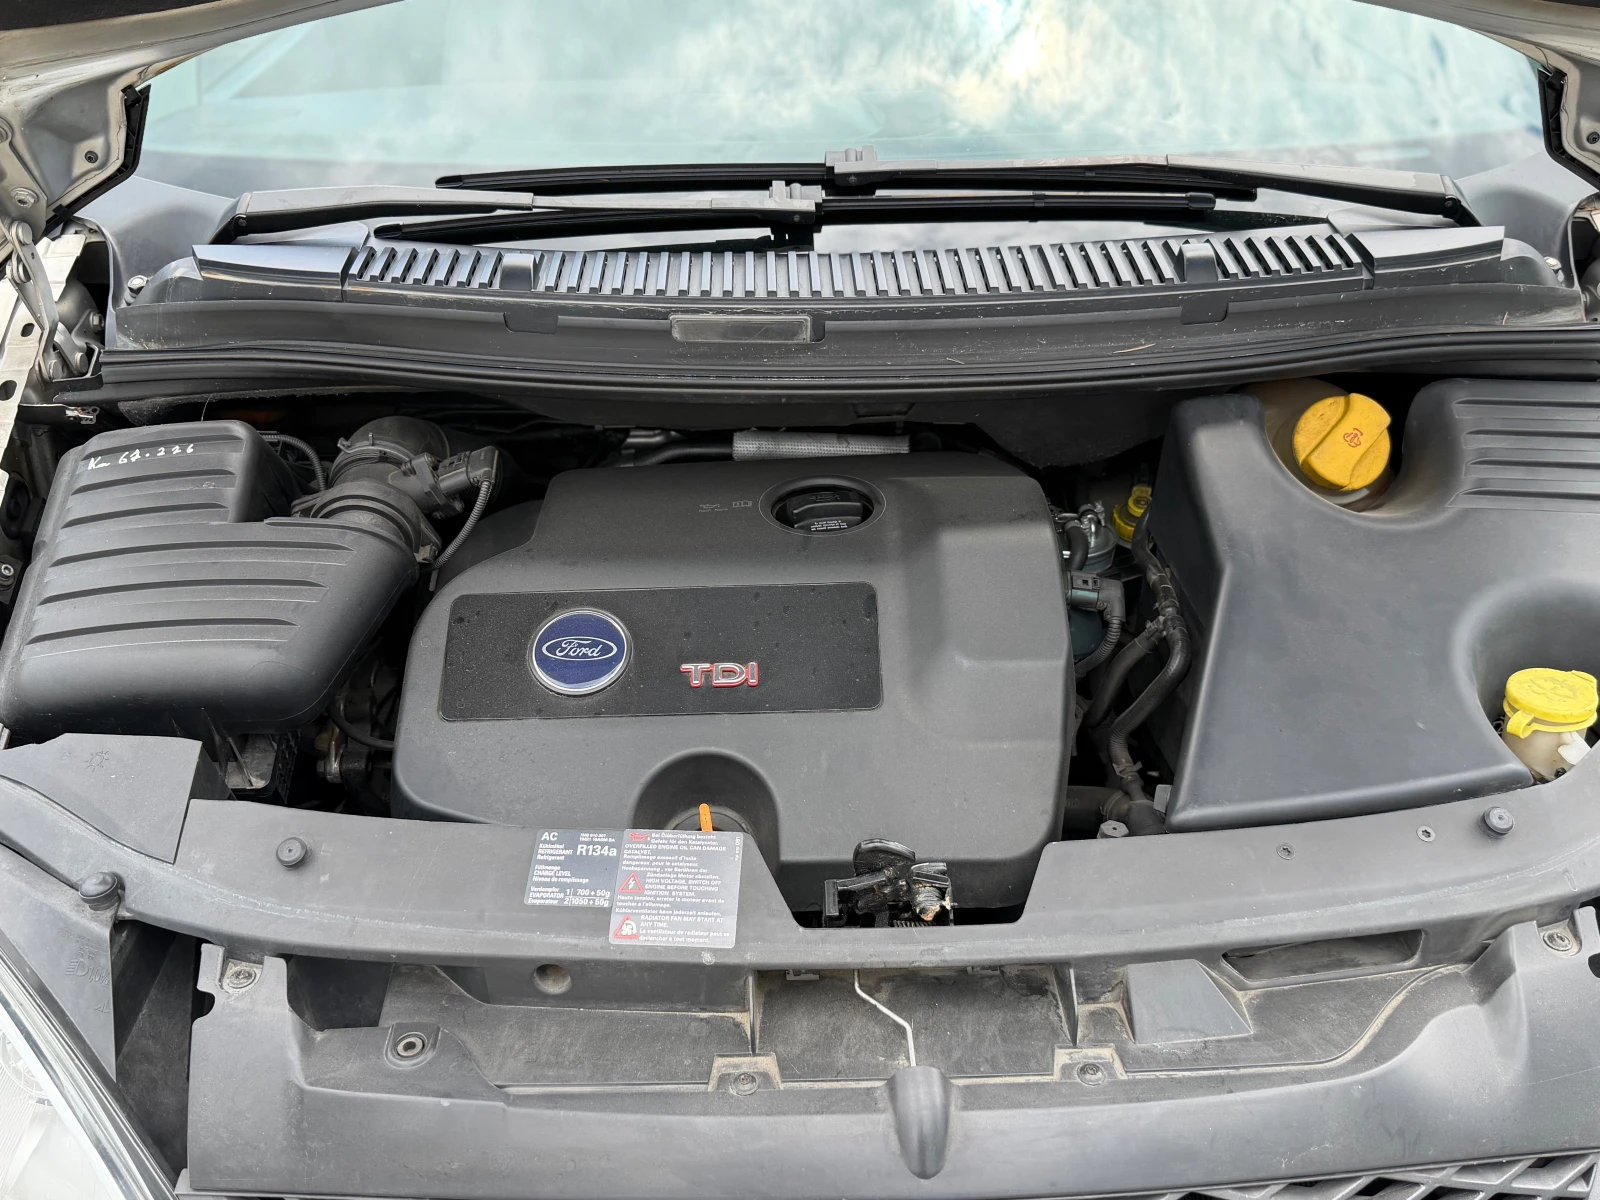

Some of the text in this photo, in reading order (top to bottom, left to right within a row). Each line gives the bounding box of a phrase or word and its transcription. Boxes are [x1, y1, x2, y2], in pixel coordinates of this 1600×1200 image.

[555, 639, 602, 657] Ford
[680, 661, 759, 688] TDI
[541, 832, 558, 841] AC
[576, 844, 617, 856] R134a
[596, 889, 610, 898] 50g
[595, 899, 609, 907] 50g
